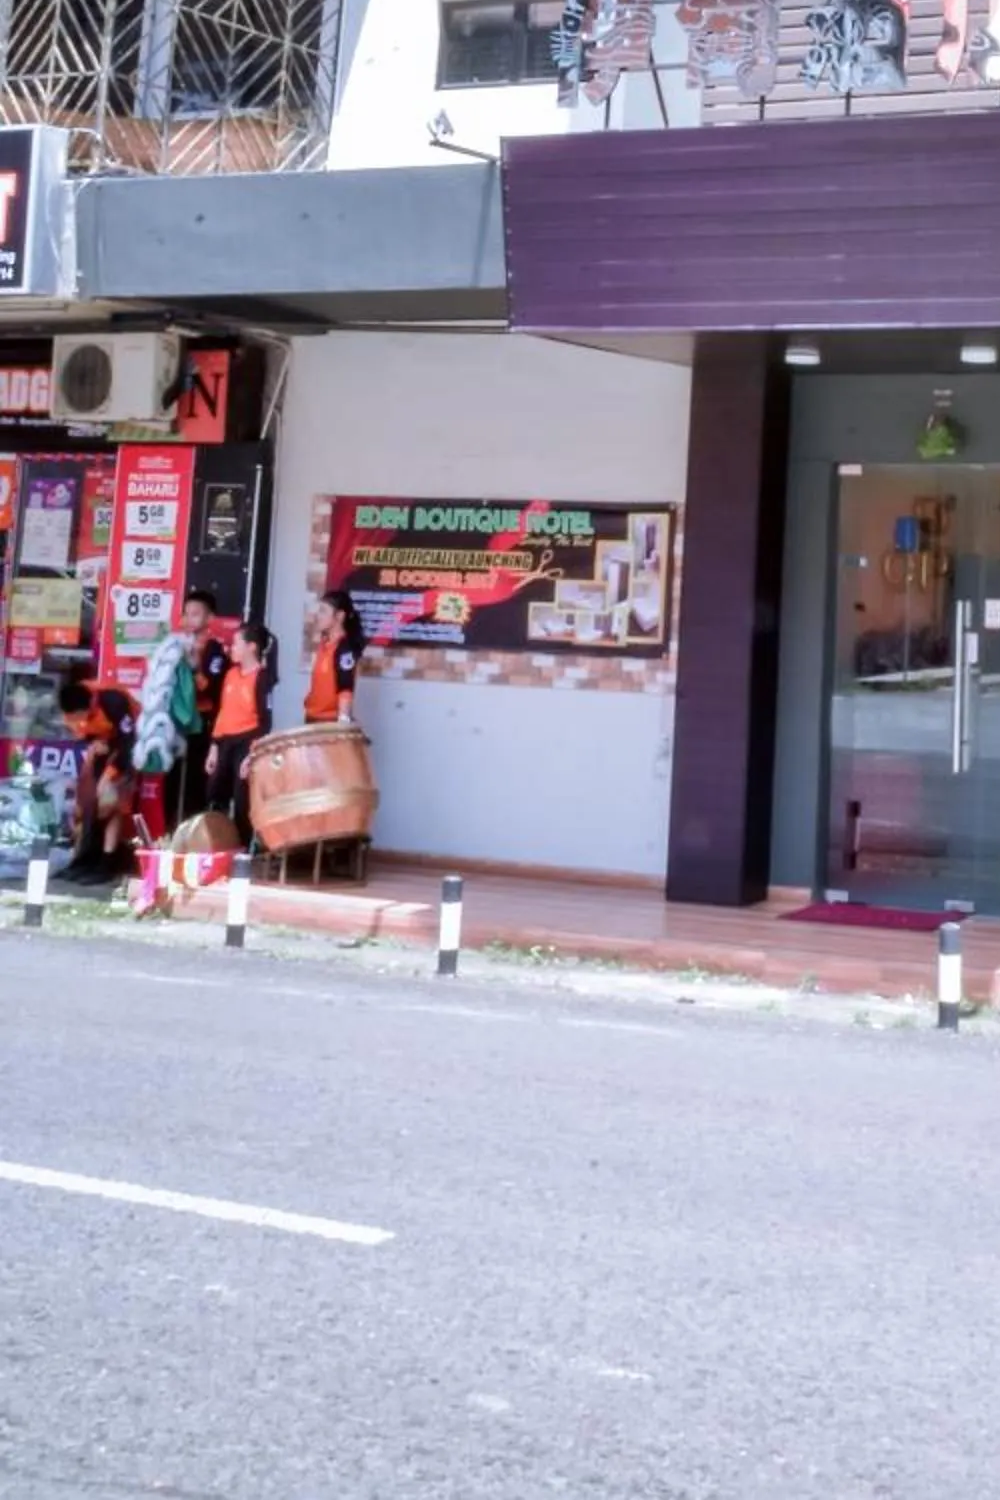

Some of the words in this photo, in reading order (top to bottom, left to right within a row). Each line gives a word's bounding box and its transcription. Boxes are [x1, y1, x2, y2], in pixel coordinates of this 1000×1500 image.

[355, 505, 410, 530] EDEN
[413, 506, 521, 533] BOUTIQUE
[526, 509, 595, 534] HOTEL
[127, 593, 140, 617] 8
[142, 593, 161, 608] GB
